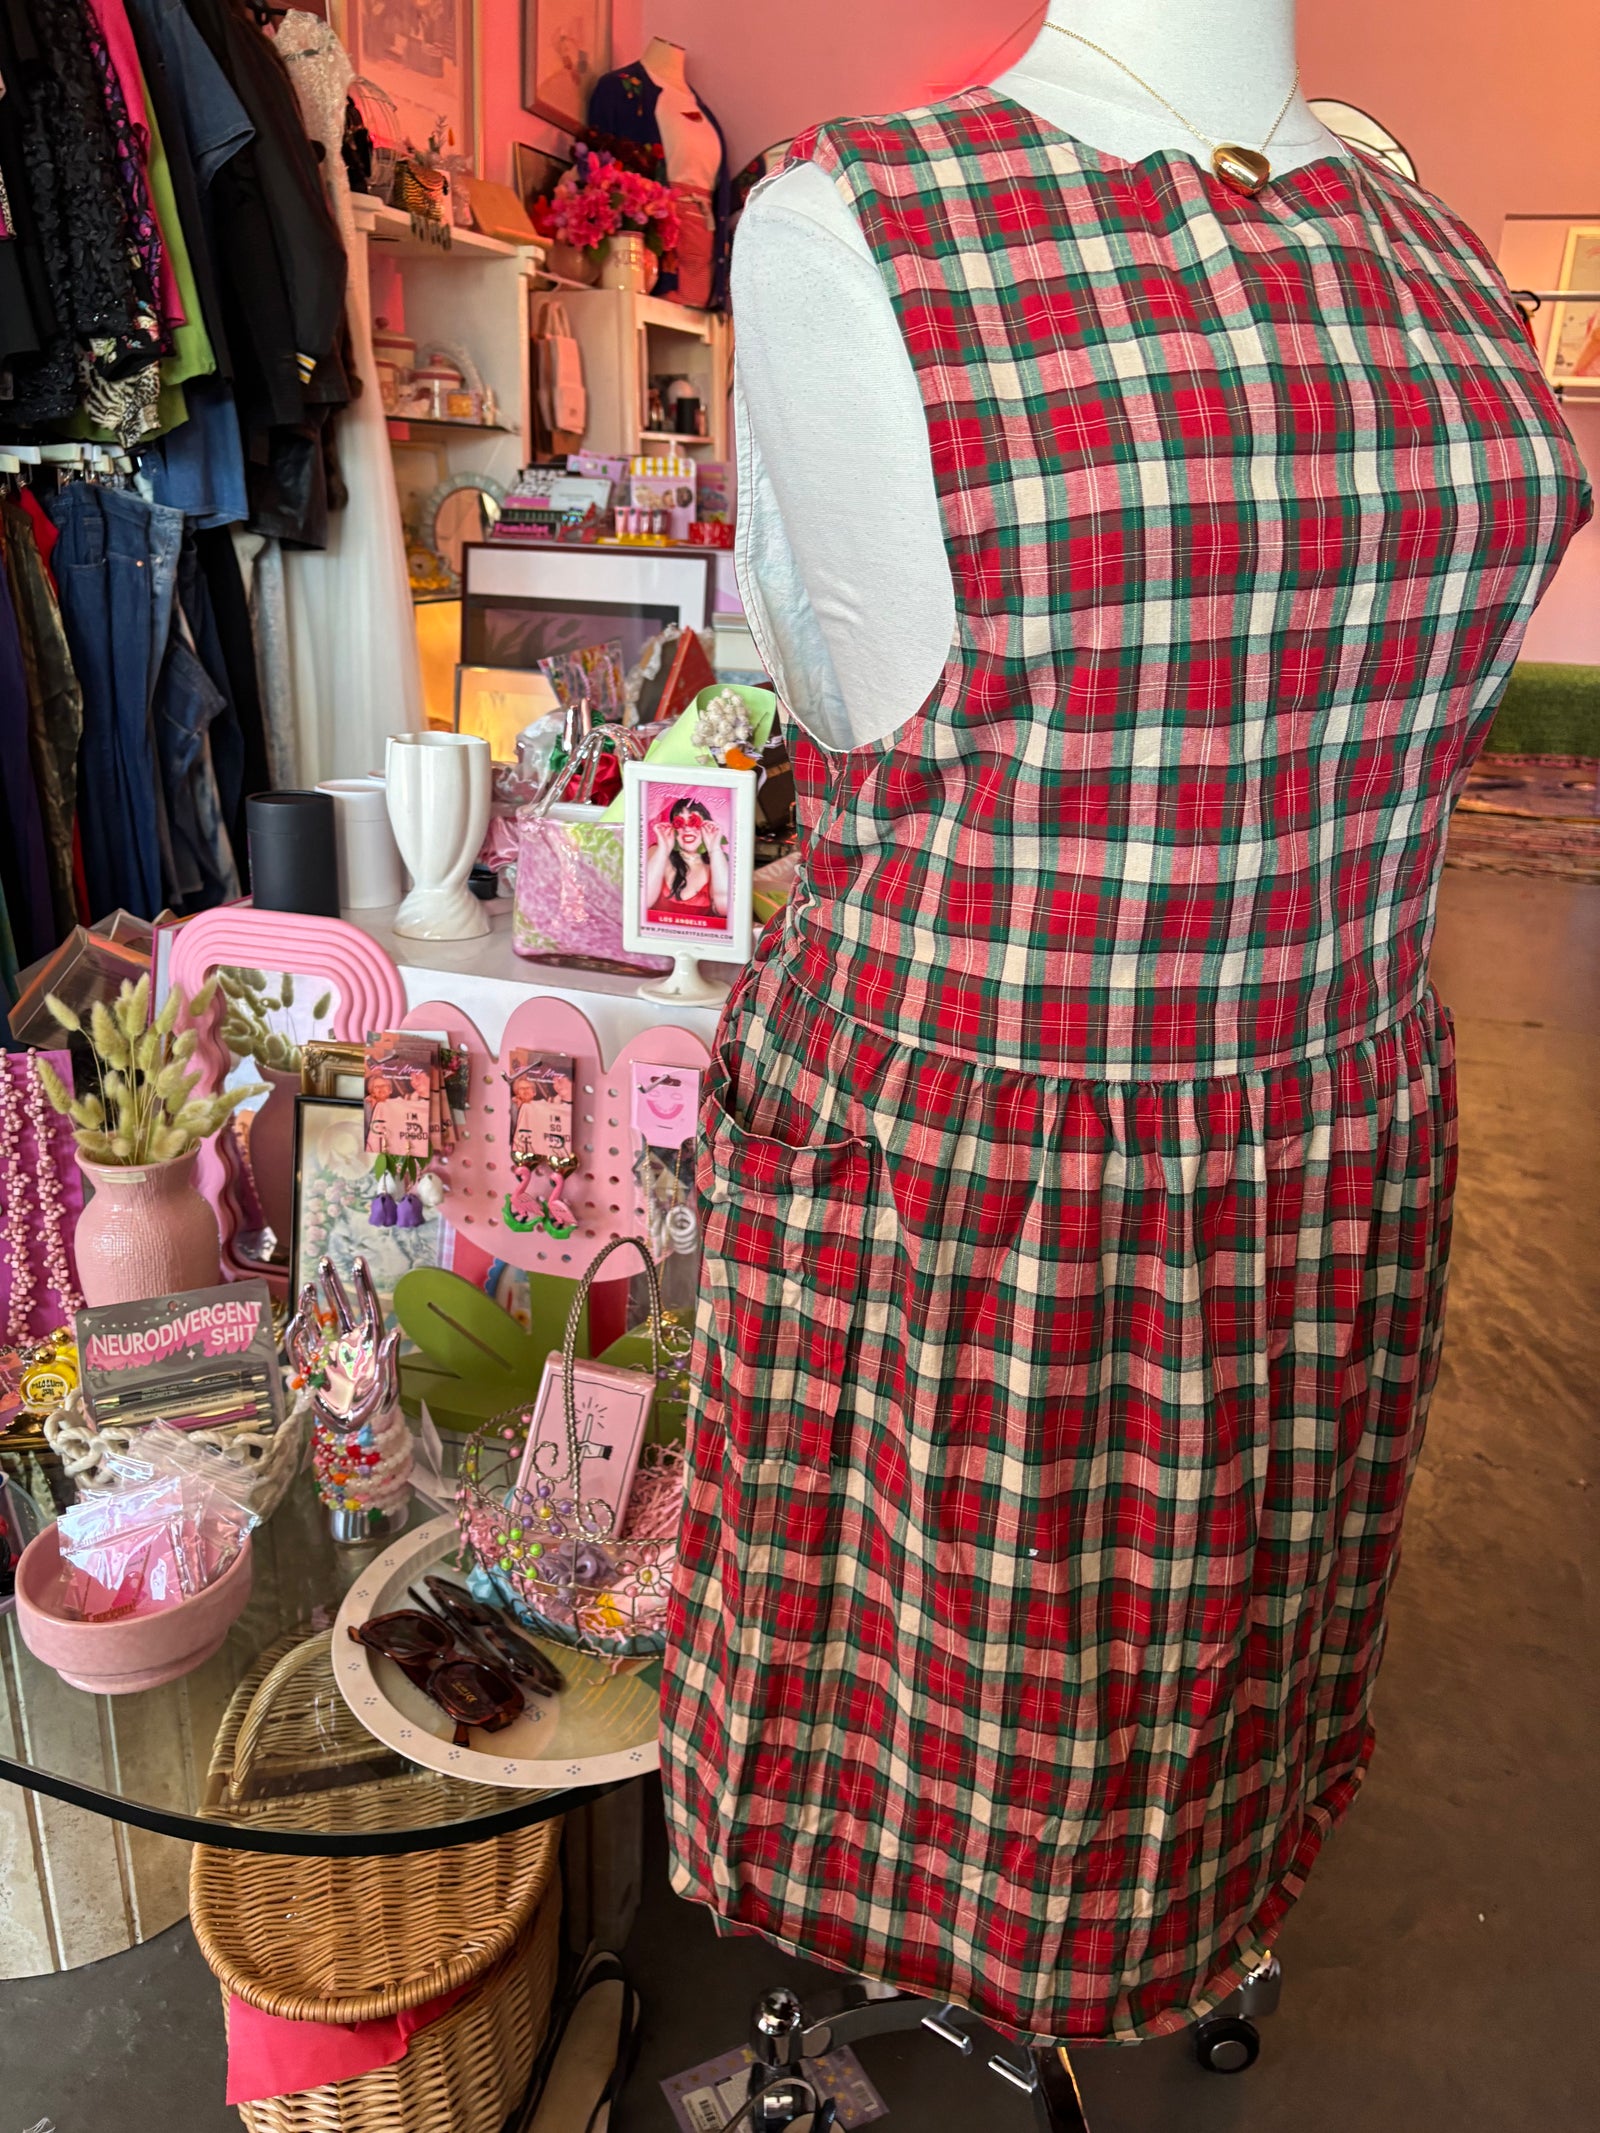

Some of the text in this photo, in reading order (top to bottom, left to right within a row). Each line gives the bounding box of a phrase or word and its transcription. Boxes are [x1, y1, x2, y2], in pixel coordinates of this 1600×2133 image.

[675, 917, 707, 926] ANGELES
[91, 1301, 262, 1357] NEURODIVERGENT
[210, 1323, 258, 1346] SHIT
